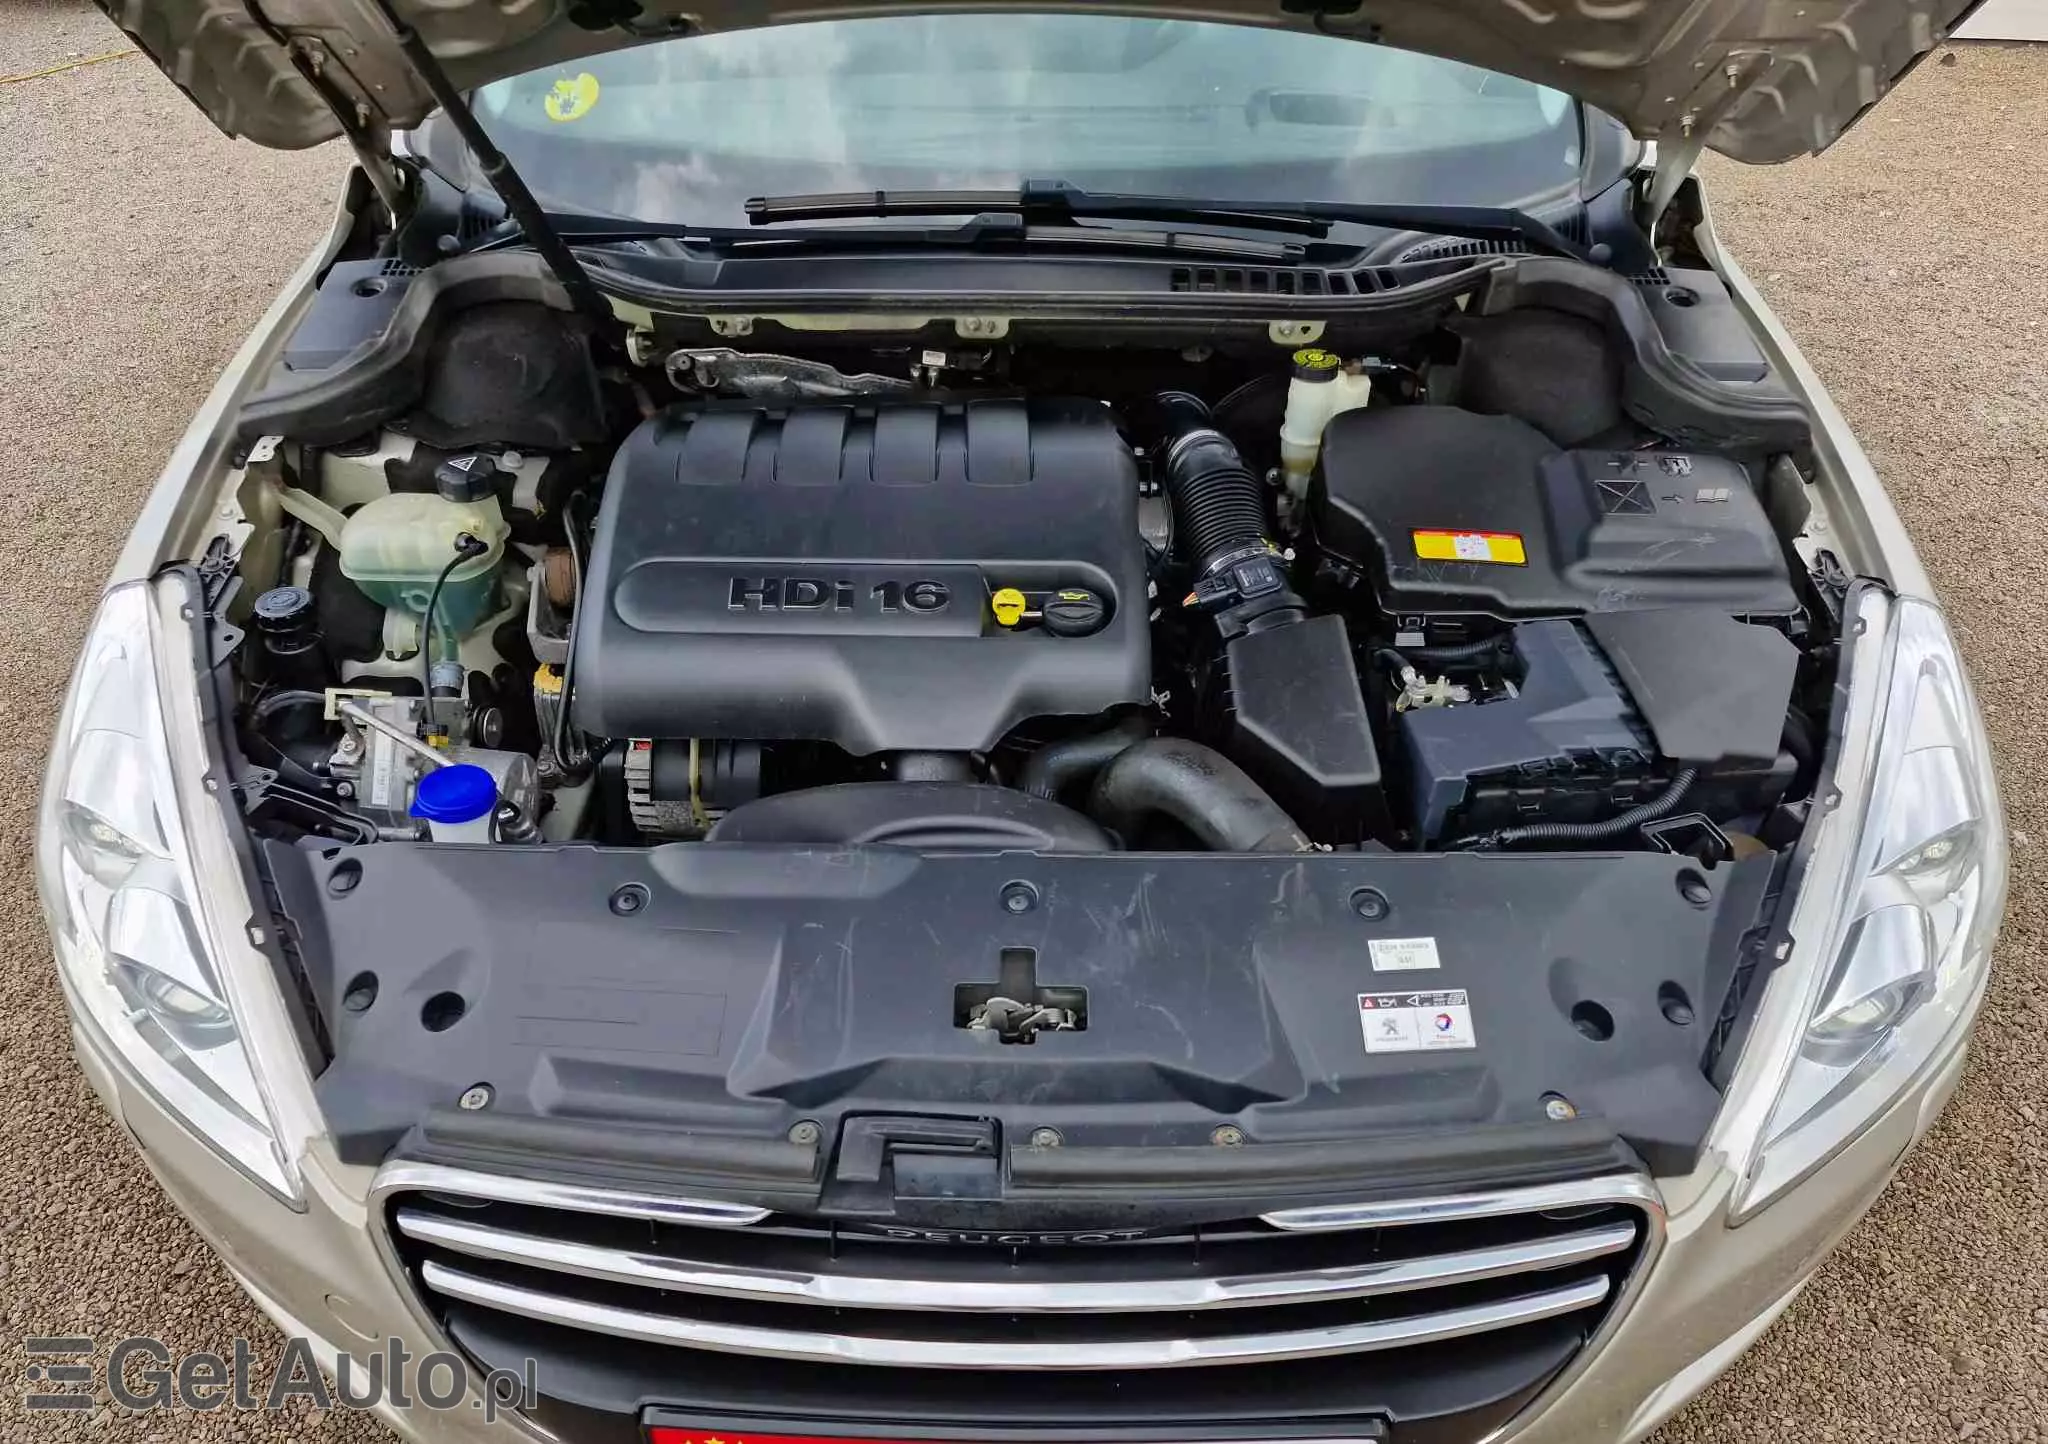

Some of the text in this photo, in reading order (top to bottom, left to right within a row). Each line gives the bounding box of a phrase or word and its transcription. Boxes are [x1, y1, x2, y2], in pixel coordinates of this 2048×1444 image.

[727, 576, 950, 614] HDi 16
[887, 1228, 1144, 1245] PEUGEOT
